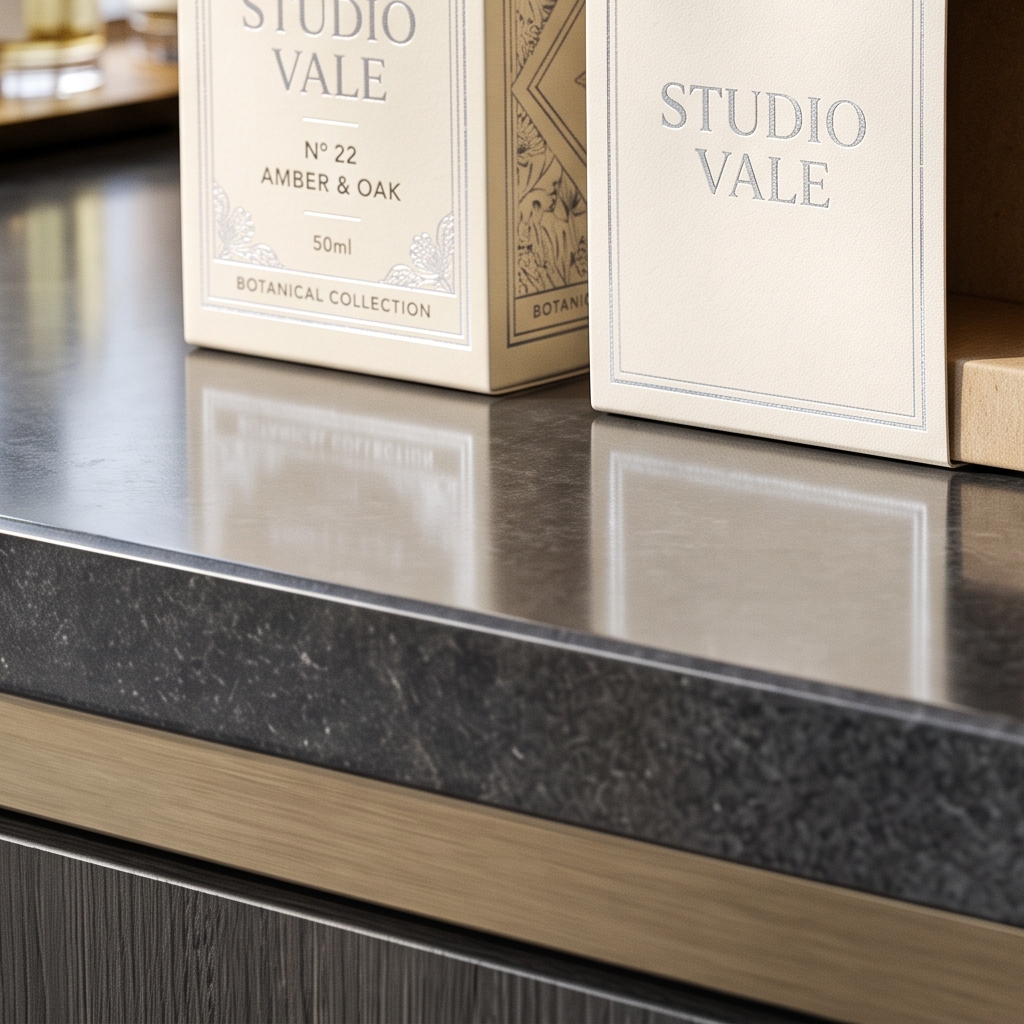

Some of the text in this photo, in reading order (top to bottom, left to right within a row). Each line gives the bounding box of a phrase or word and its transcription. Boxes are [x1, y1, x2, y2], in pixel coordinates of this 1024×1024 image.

[271, 47, 387, 103] VALE
[660, 81, 867, 149] STUDIO
[334, 143, 358, 166] 22
[260, 166, 402, 202] AMBER & OAK
[695, 147, 831, 209] VALE
[312, 234, 353, 256] 50ml
[236, 275, 432, 319] BOTANICAL COLLECTION
